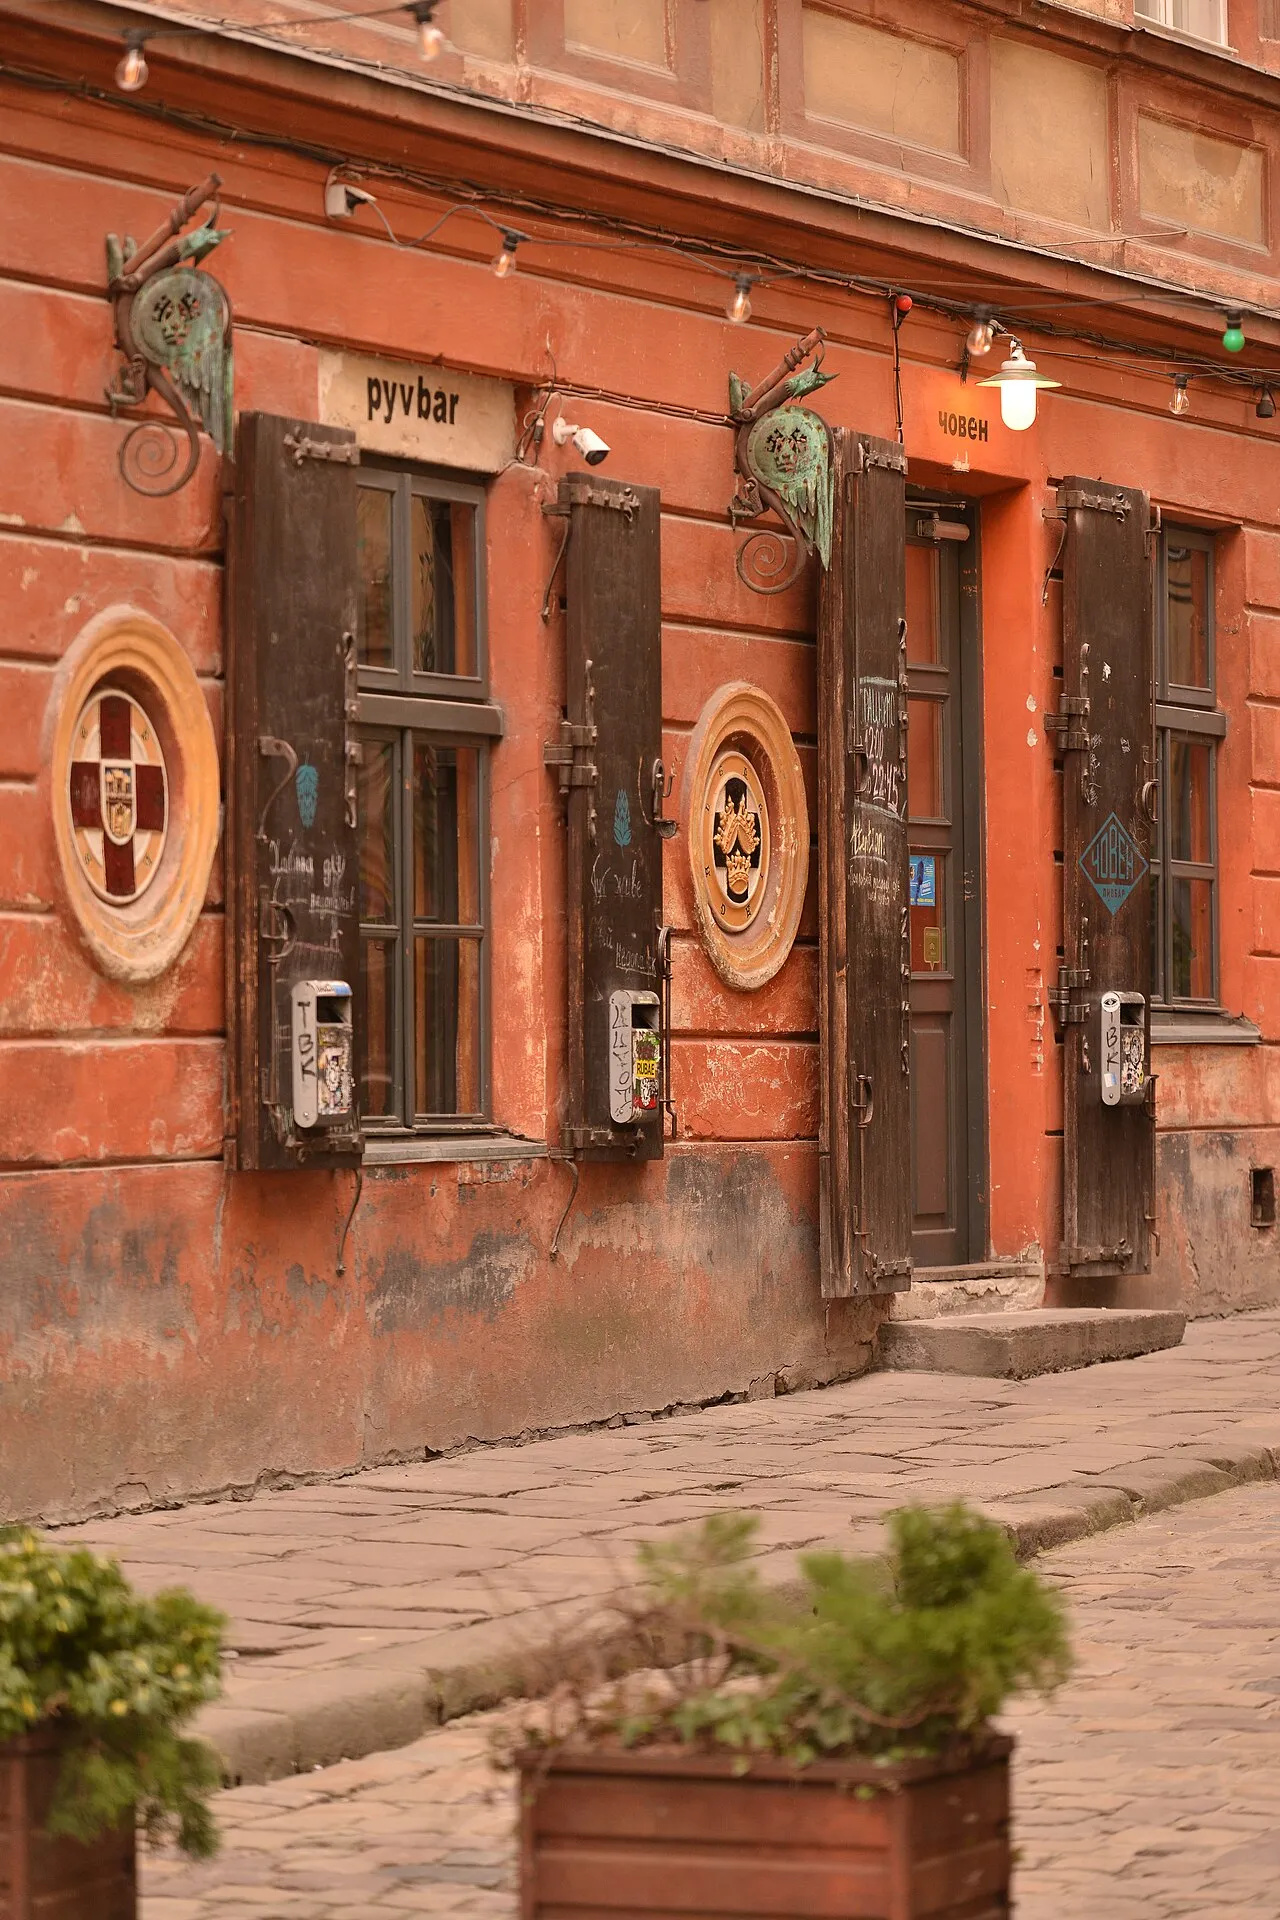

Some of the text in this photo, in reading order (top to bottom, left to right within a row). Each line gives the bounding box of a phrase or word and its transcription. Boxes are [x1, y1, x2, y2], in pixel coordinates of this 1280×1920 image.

[367, 375, 460, 425] pyvbar
[938, 410, 989, 442] човен
[1091, 824, 1134, 880] ЧОВЕН
[1102, 887, 1126, 899] ПИВБАР
